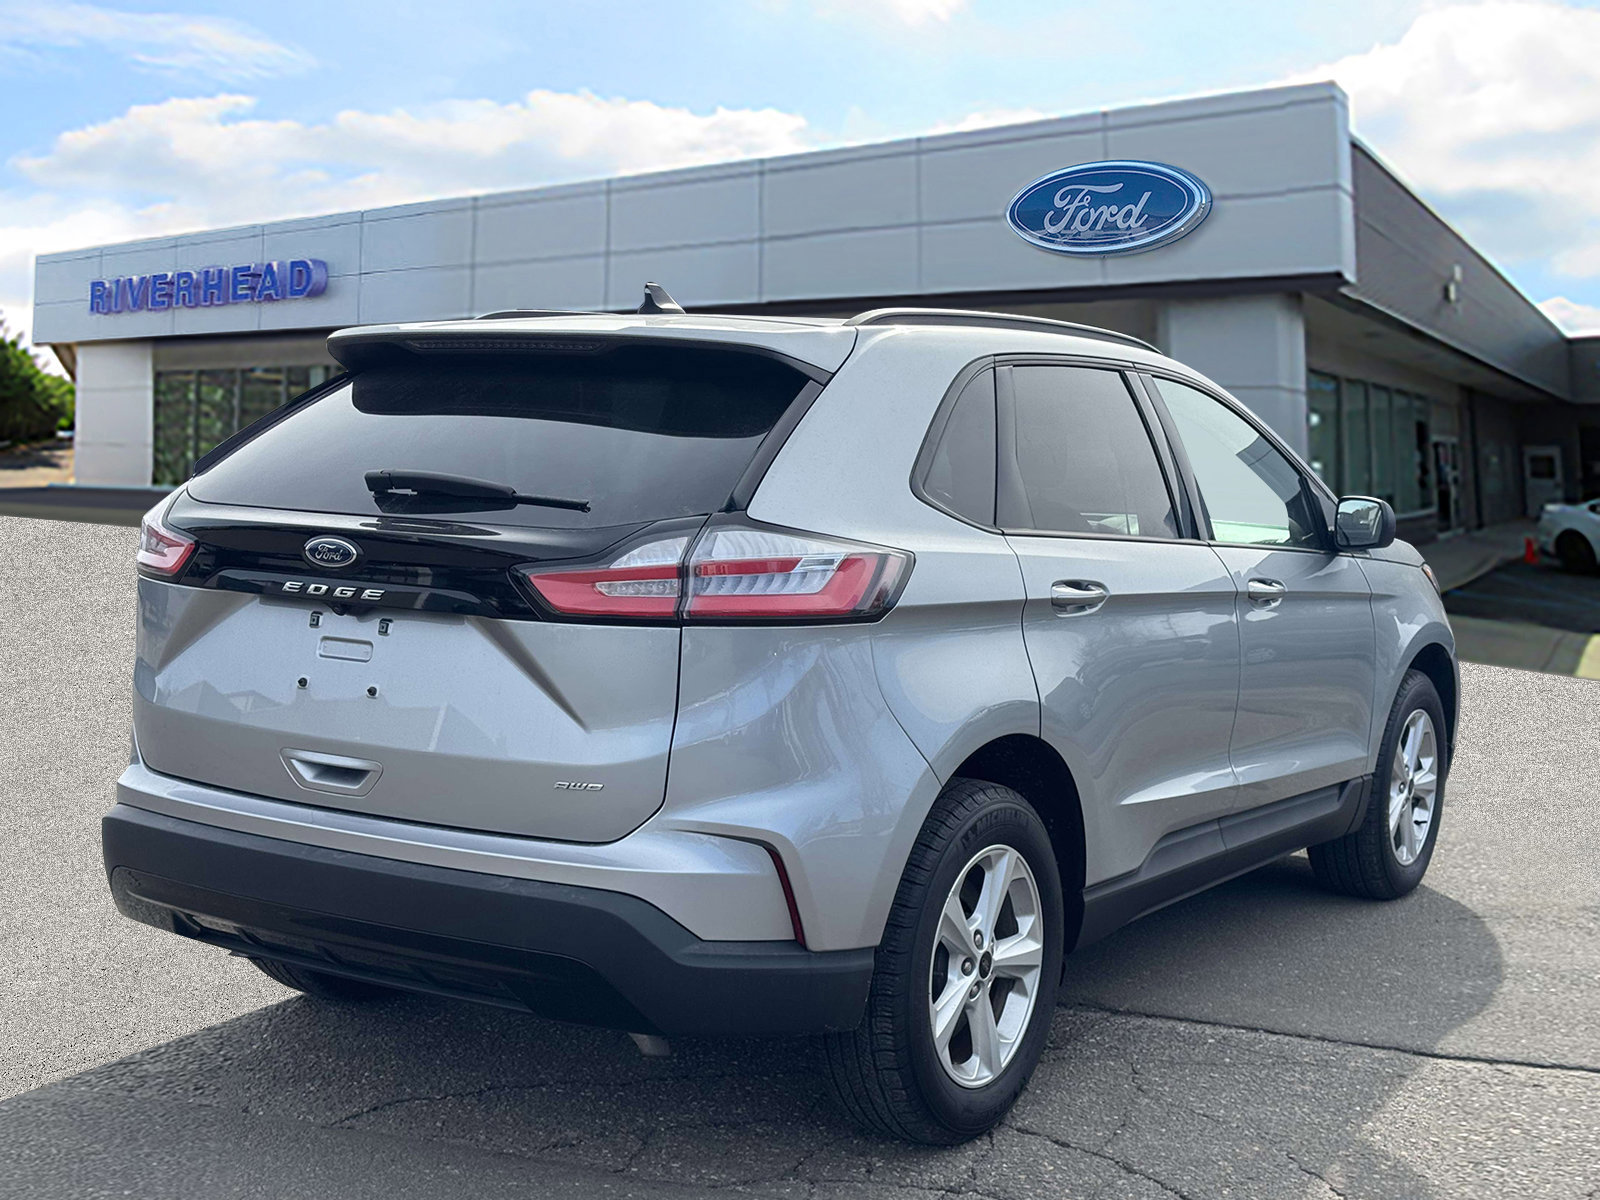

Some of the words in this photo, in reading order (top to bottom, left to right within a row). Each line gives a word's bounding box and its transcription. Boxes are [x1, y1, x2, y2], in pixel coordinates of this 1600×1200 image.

[1043, 182, 1152, 234] Ford
[89, 258, 325, 315] RIVERHEAD
[314, 543, 343, 561] Ford
[281, 581, 386, 601] EDGE
[554, 781, 604, 791] AWD
